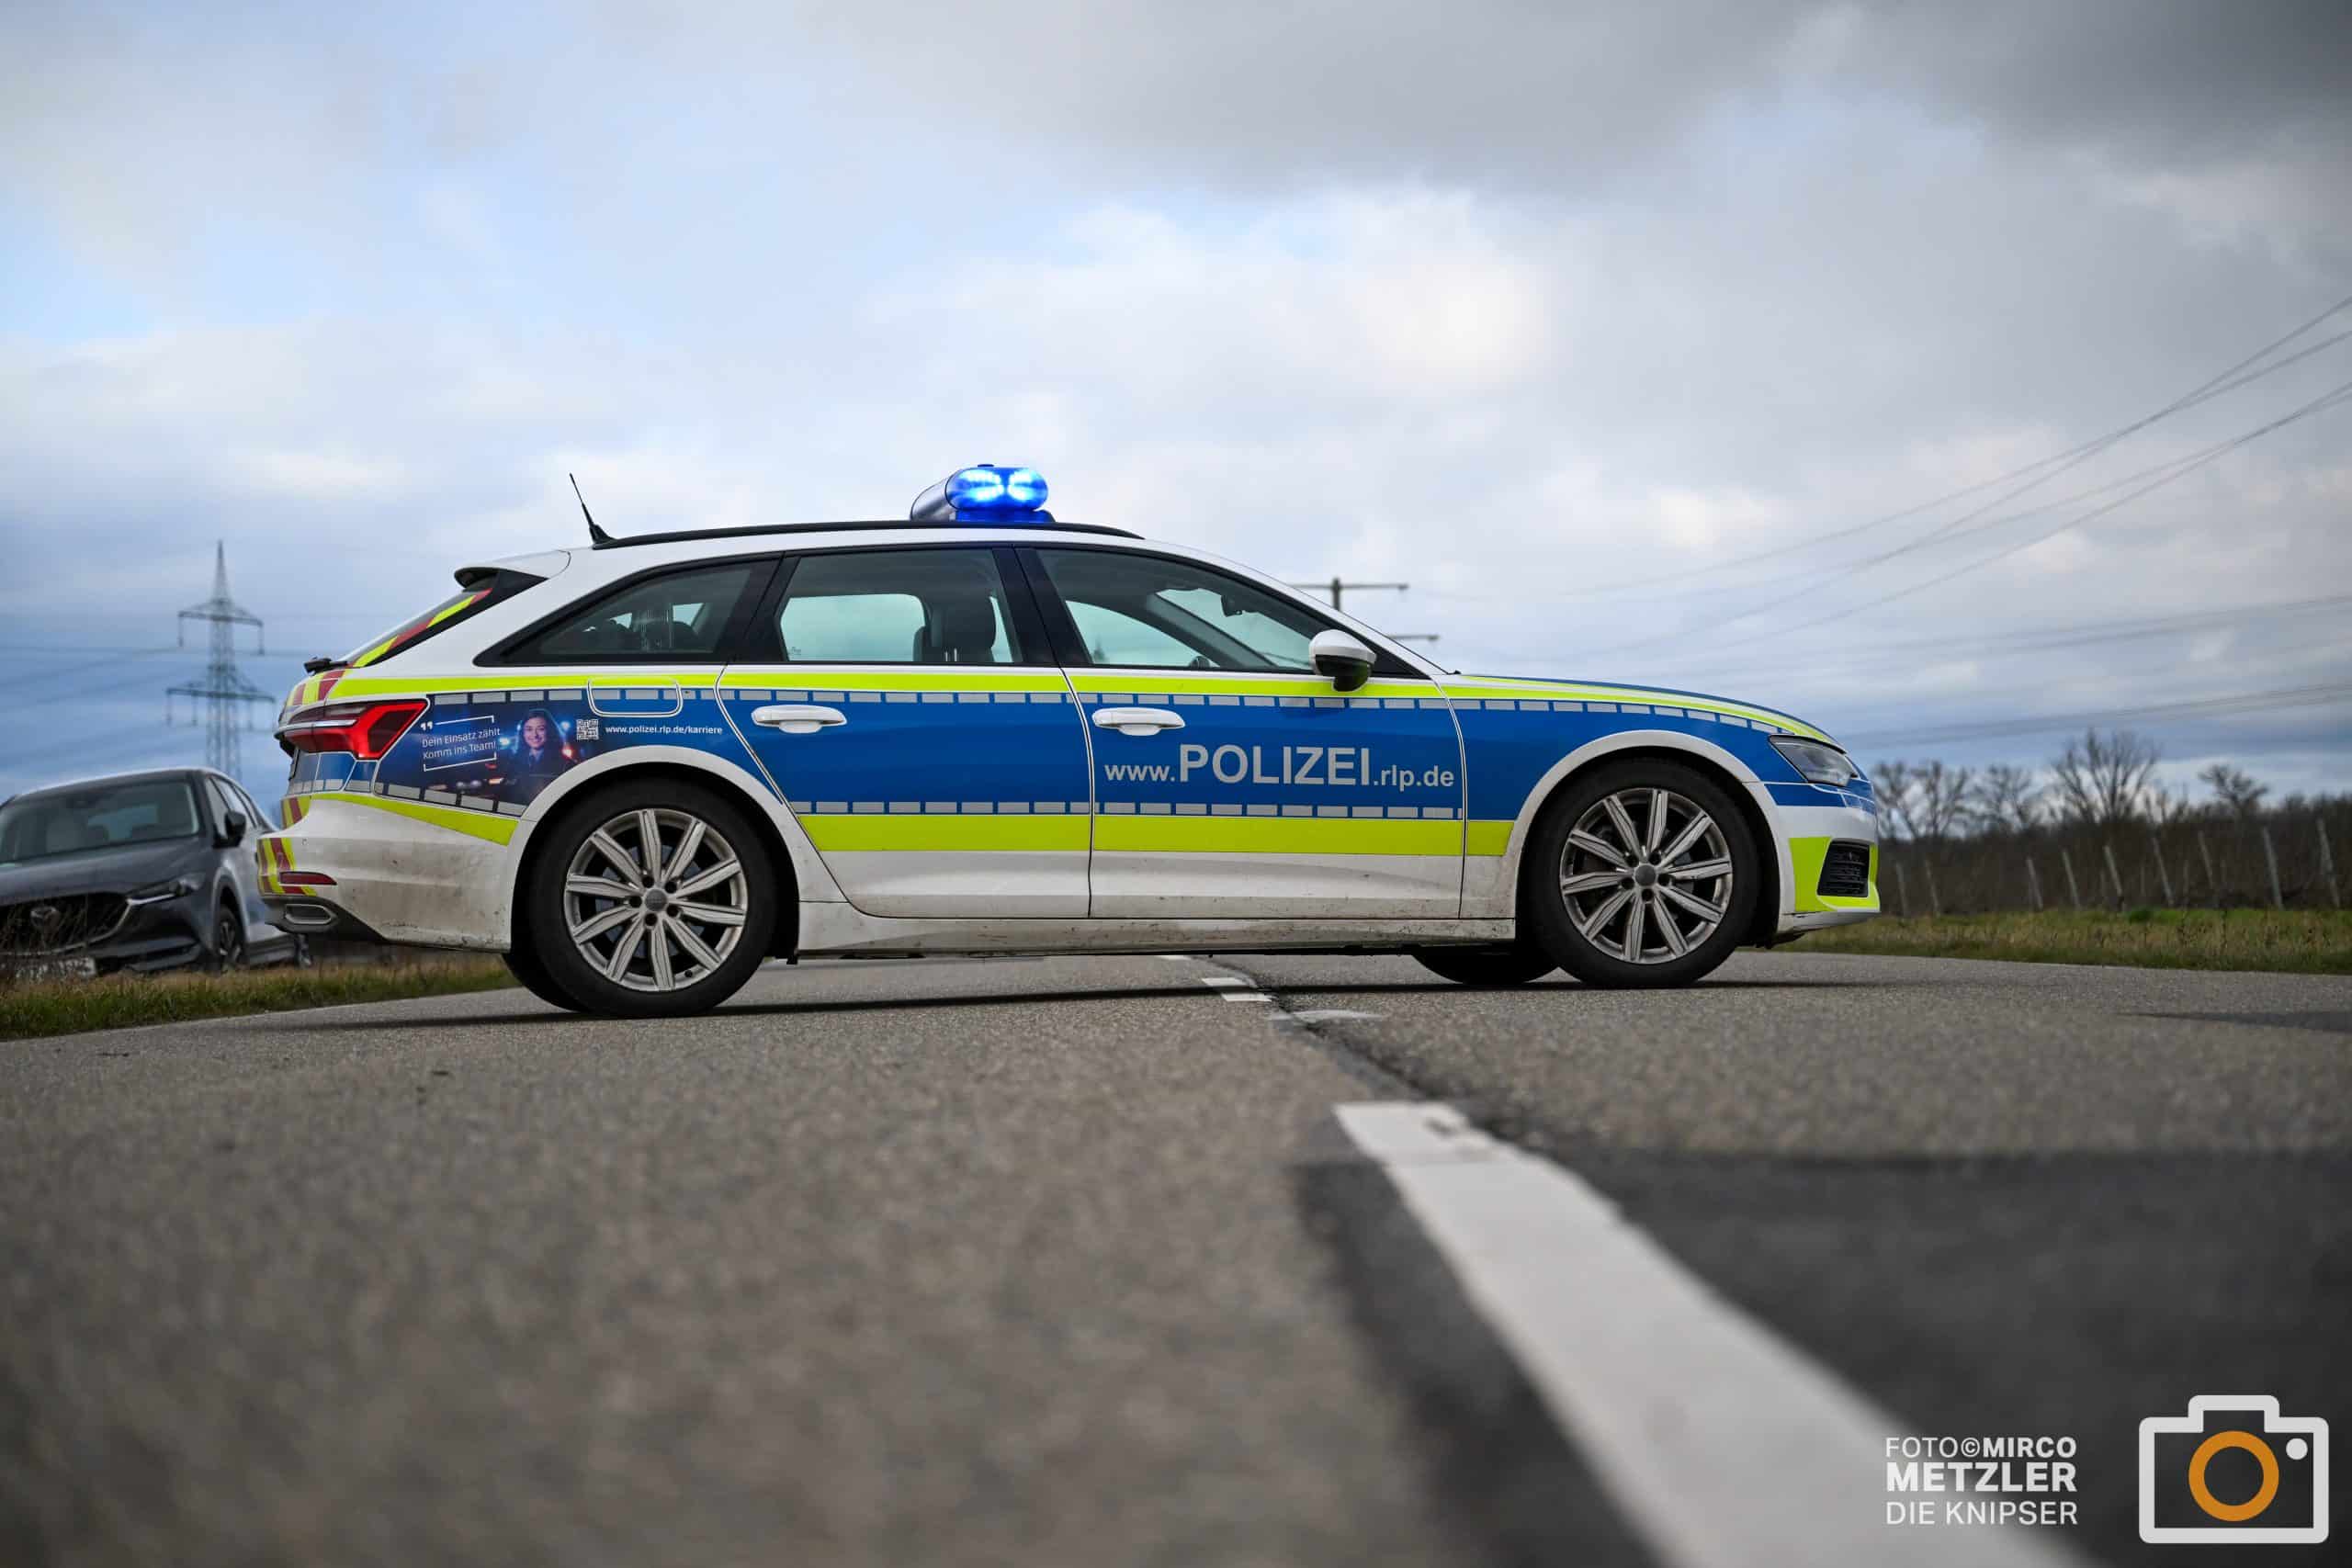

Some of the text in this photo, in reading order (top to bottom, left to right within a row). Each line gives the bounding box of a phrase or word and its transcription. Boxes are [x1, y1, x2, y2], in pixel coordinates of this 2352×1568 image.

[605, 725, 723, 735] www.polizei.rlp.de/karriere
[423, 728, 501, 748] Dein Einsatz zählt
[424, 749, 452, 760] Komm
[454, 745, 468, 755] ins
